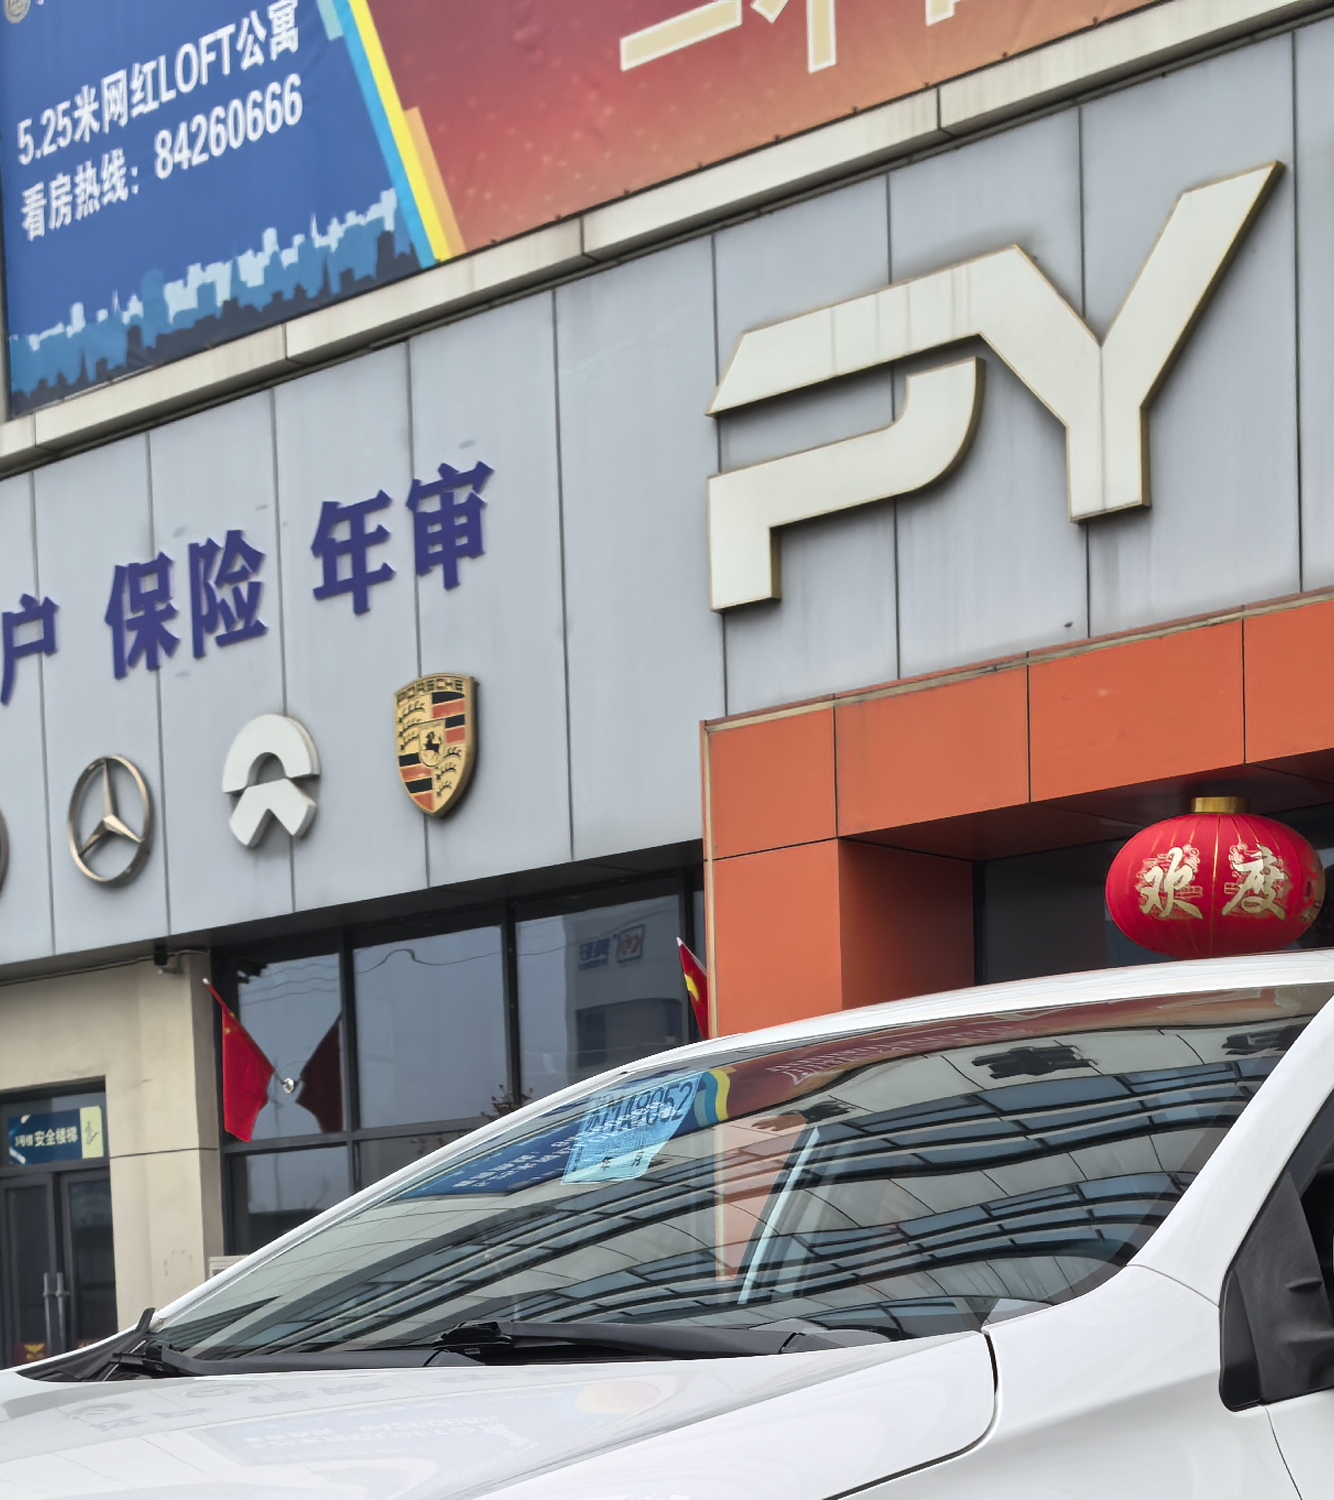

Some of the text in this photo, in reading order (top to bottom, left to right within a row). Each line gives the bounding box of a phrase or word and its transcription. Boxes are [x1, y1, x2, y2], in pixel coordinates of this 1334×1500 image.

[18, 0, 300, 166] 5.25米网红LOFT公寓
[706, 160, 1285, 613] PY
[104, 529, 269, 680] 保险
[310, 462, 495, 616] 年审
[1139, 845, 1287, 921] 欢度
